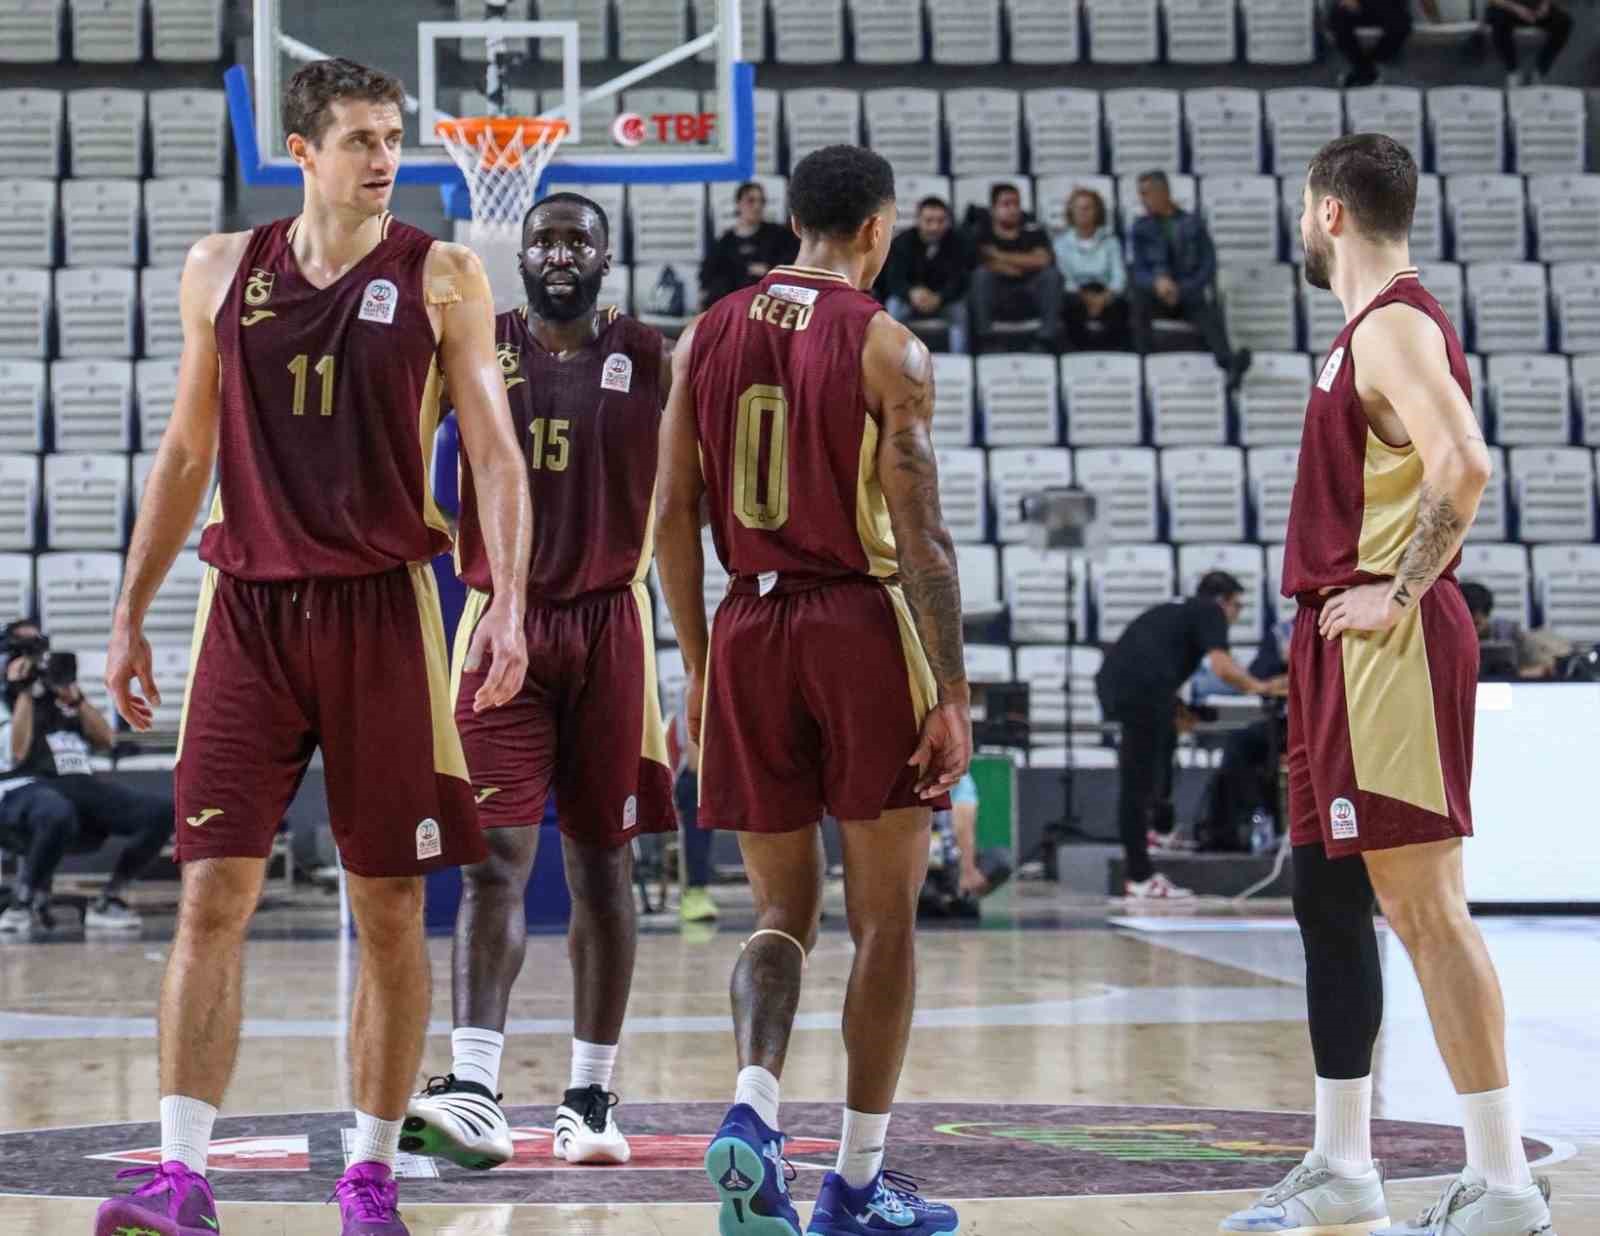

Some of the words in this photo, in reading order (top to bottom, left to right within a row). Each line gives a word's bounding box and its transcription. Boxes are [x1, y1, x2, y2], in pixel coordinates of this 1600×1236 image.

[651, 112, 718, 143] TBF
[748, 294, 814, 331] REED
[287, 354, 334, 416] 11
[528, 417, 570, 471] 15
[733, 384, 789, 530] 0
